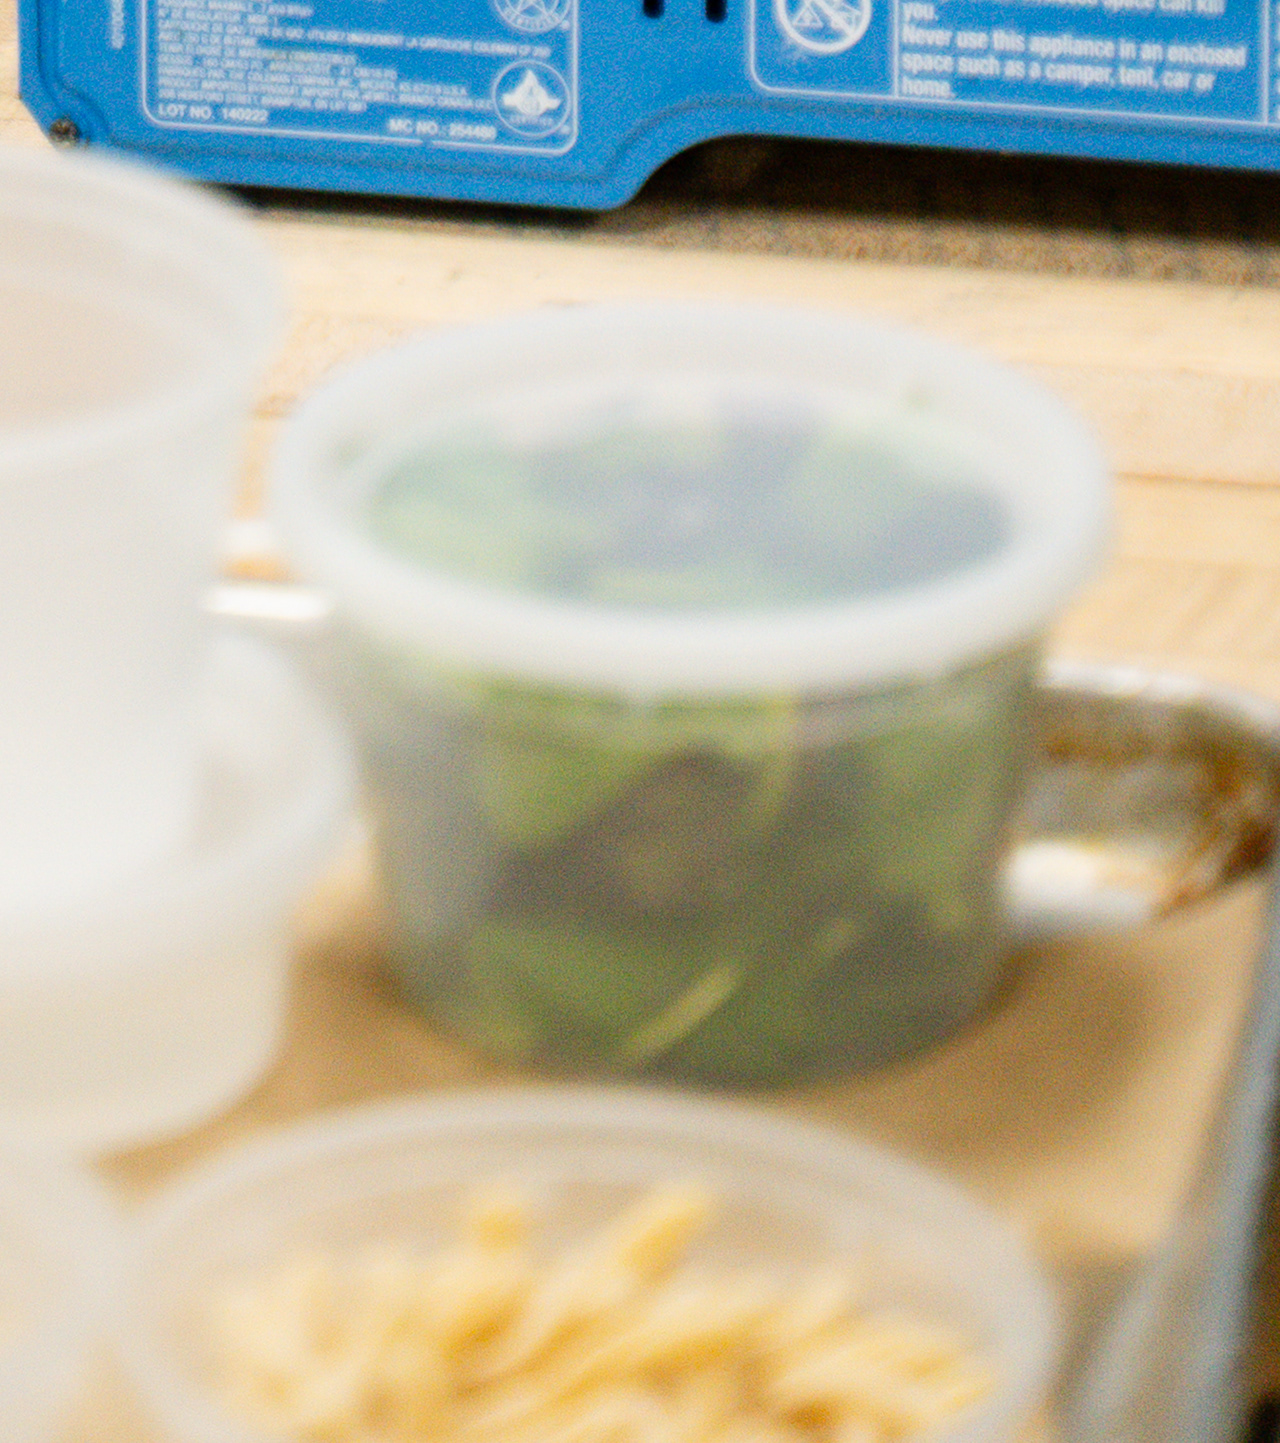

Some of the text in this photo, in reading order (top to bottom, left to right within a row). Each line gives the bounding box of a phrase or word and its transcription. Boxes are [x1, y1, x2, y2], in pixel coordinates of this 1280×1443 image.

[903, 2, 939, 22] you.
[903, 23, 1247, 67] Never use this appliance in an enclosed
[902, 52, 954, 74] space
[958, 55, 1000, 75] such
[1004, 60, 1026, 78] as
[1028, 60, 1041, 78] a
[1162, 71, 1191, 89] car
[903, 75, 956, 99] home.
[159, 104, 187, 117] LOT
[389, 118, 413, 133] MC
